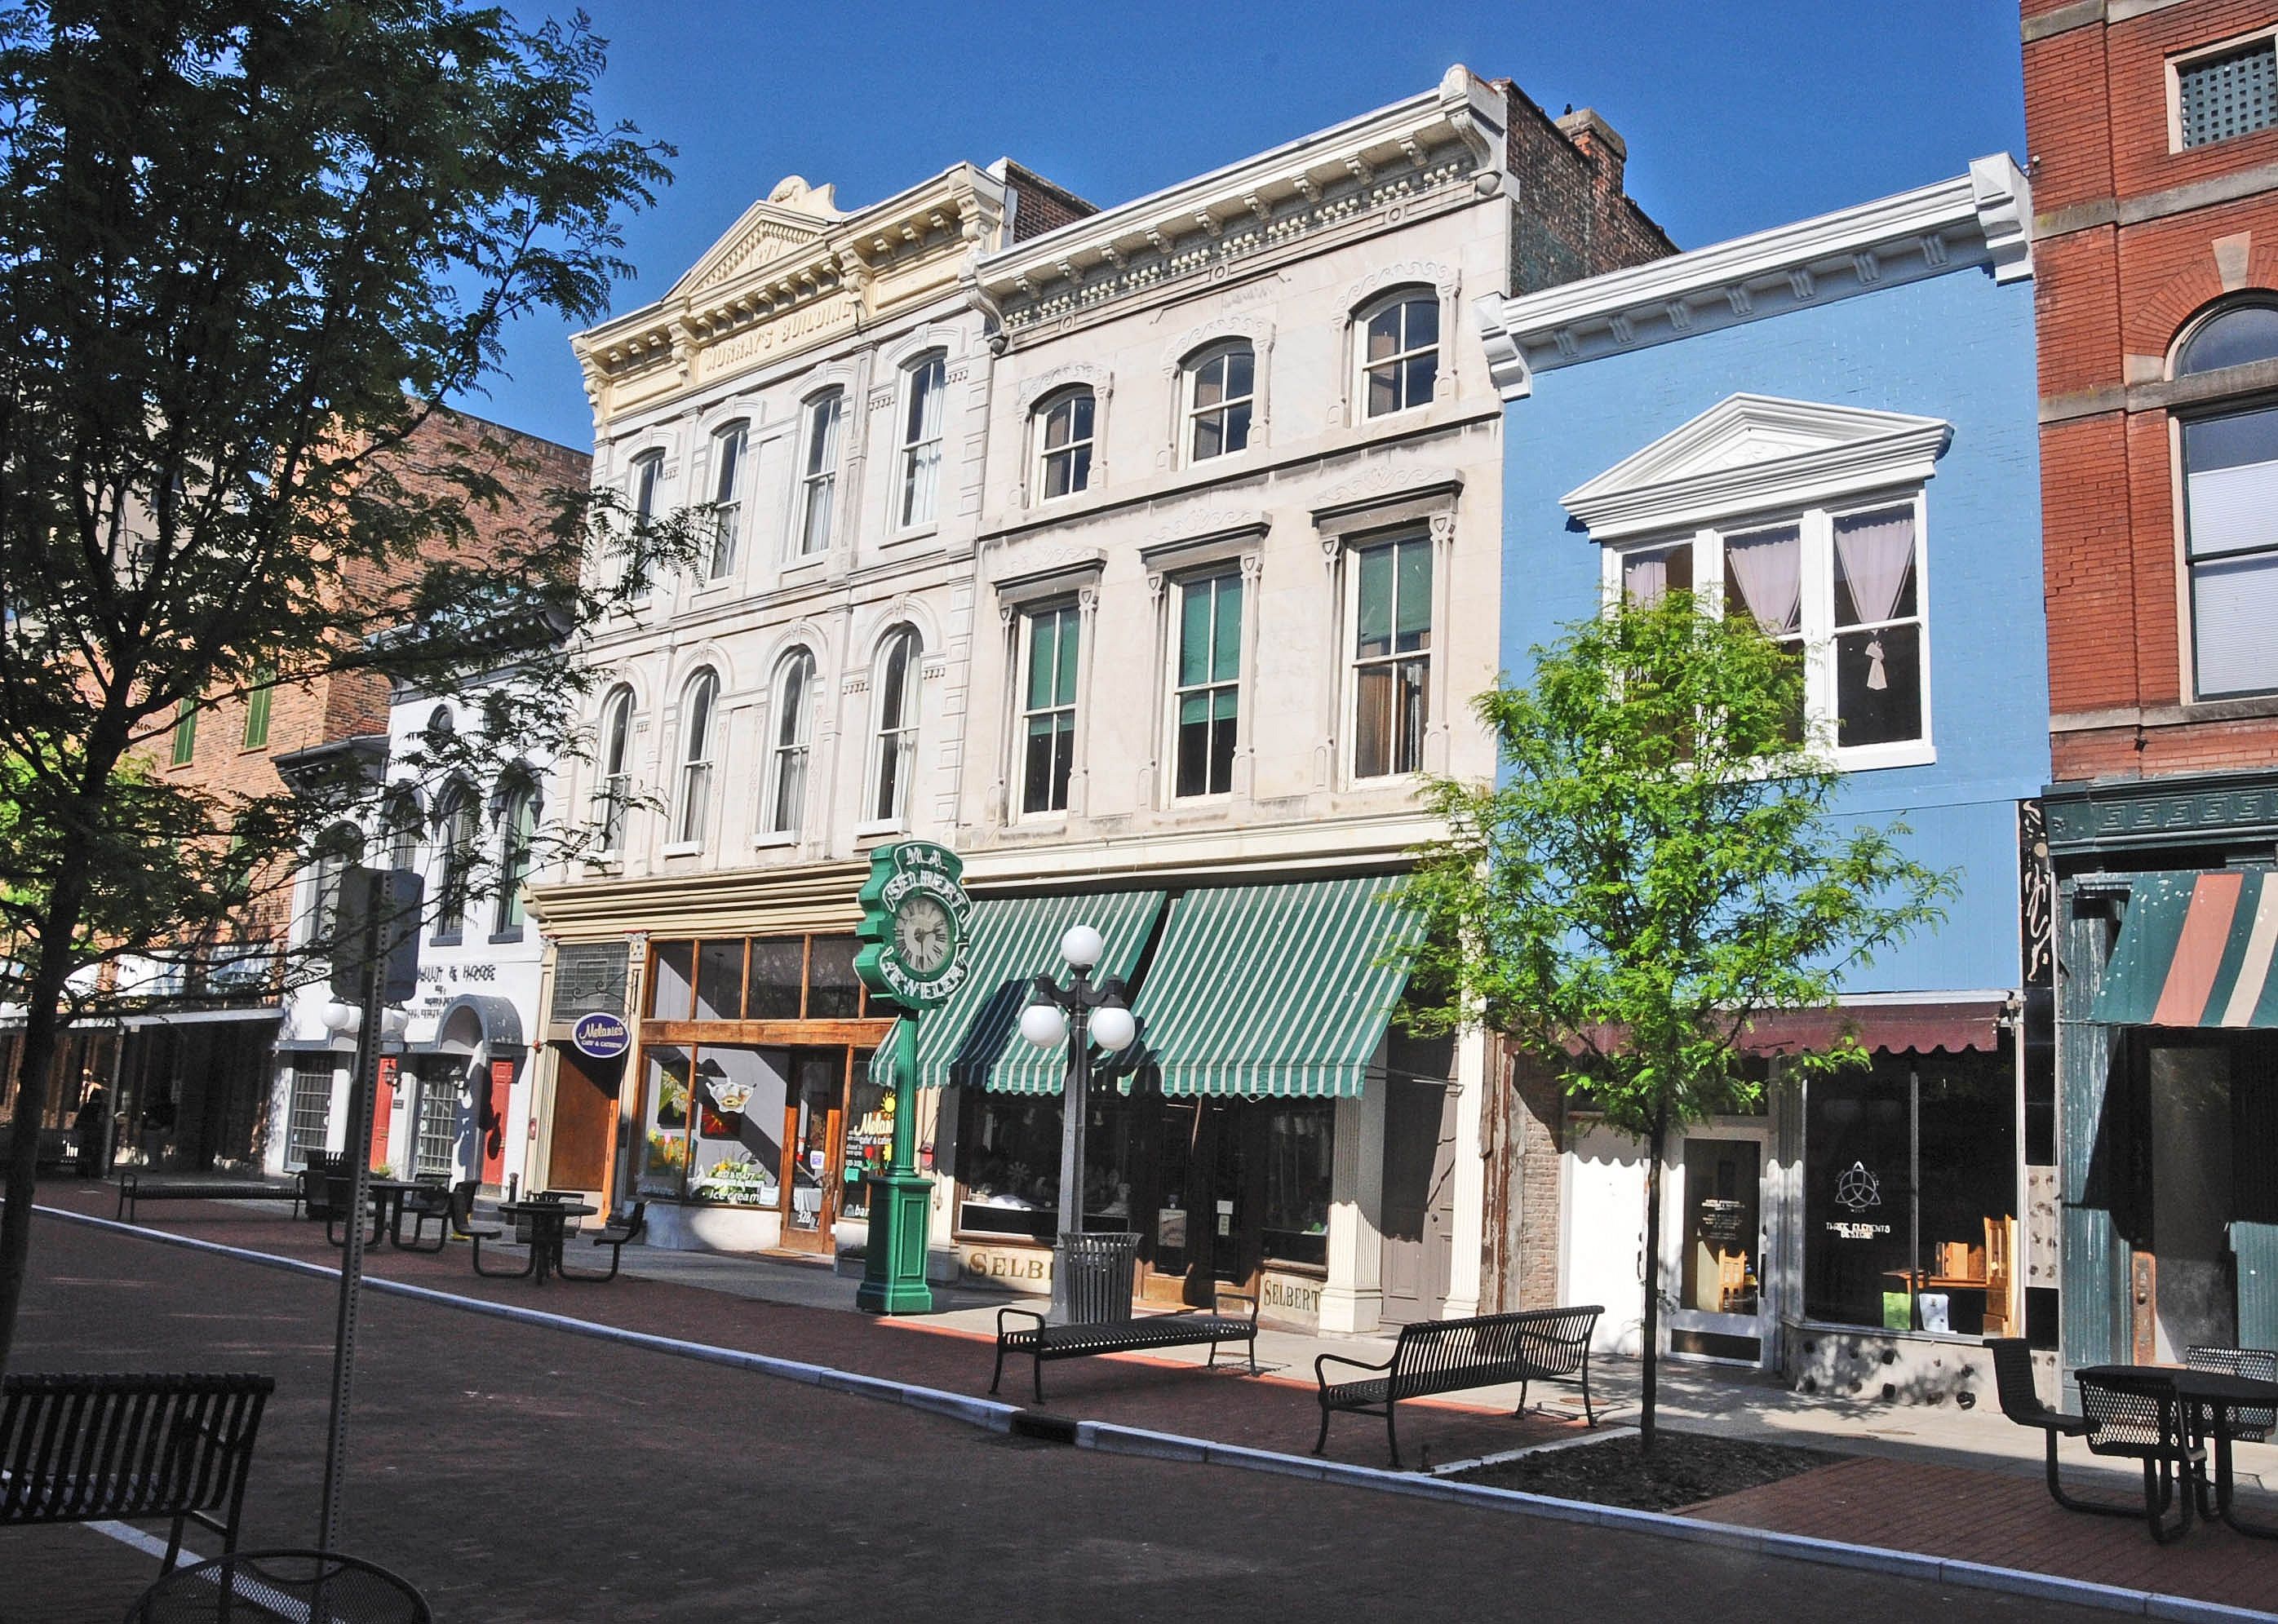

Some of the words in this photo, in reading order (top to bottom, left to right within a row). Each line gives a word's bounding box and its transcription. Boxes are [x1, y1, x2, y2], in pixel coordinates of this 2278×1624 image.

[781, 300, 851, 343] BUILDING
[887, 870, 966, 909] SELBERT
[709, 1188, 724, 1200] ice
[727, 1191, 760, 1201] cream
